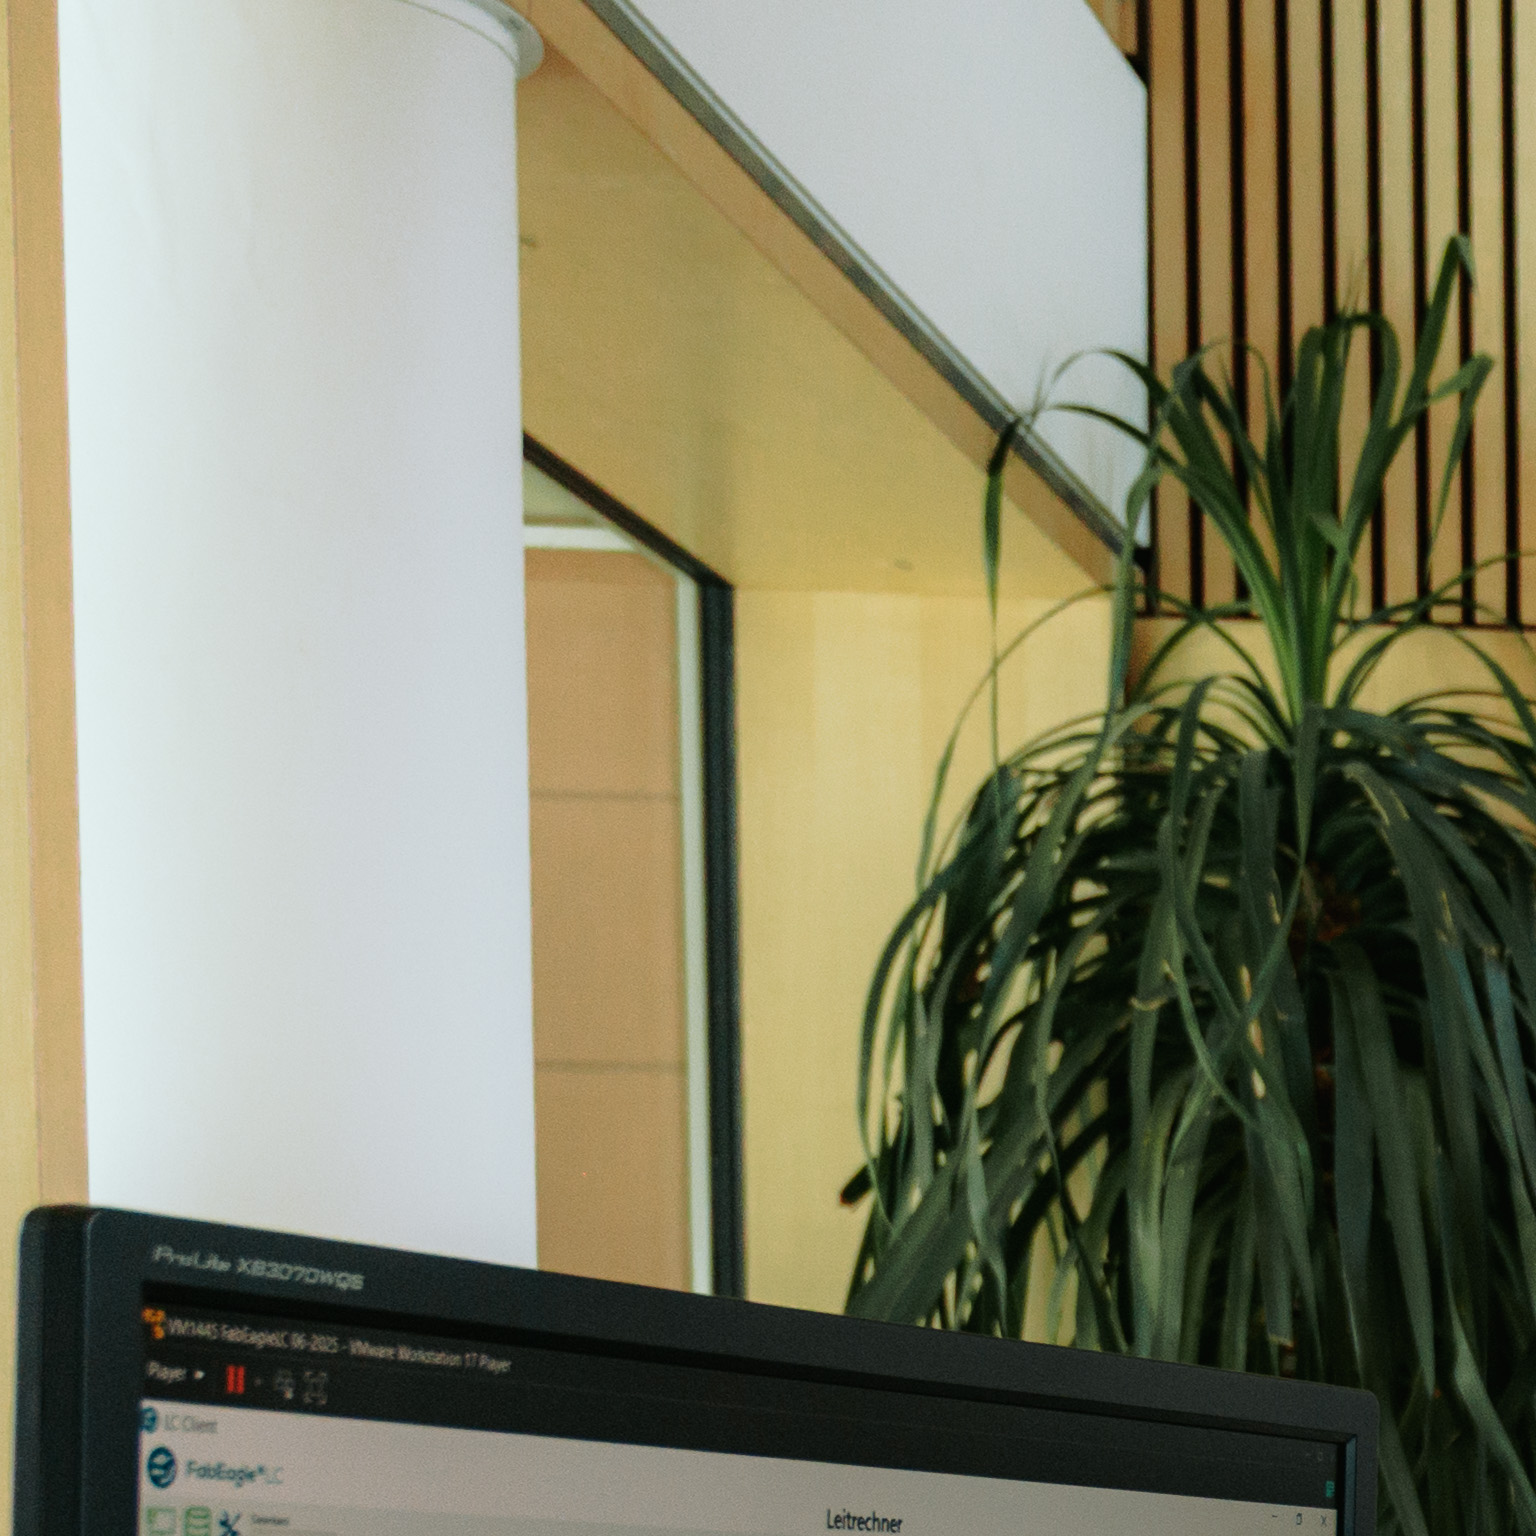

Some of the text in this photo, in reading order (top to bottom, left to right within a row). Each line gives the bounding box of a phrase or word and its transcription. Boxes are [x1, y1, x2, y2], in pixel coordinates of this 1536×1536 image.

[152, 1244, 232, 1272] ProLite
[147, 1360, 187, 1383] Player
[182, 1415, 219, 1433] Client
[826, 1508, 903, 1535] Leitrechner
